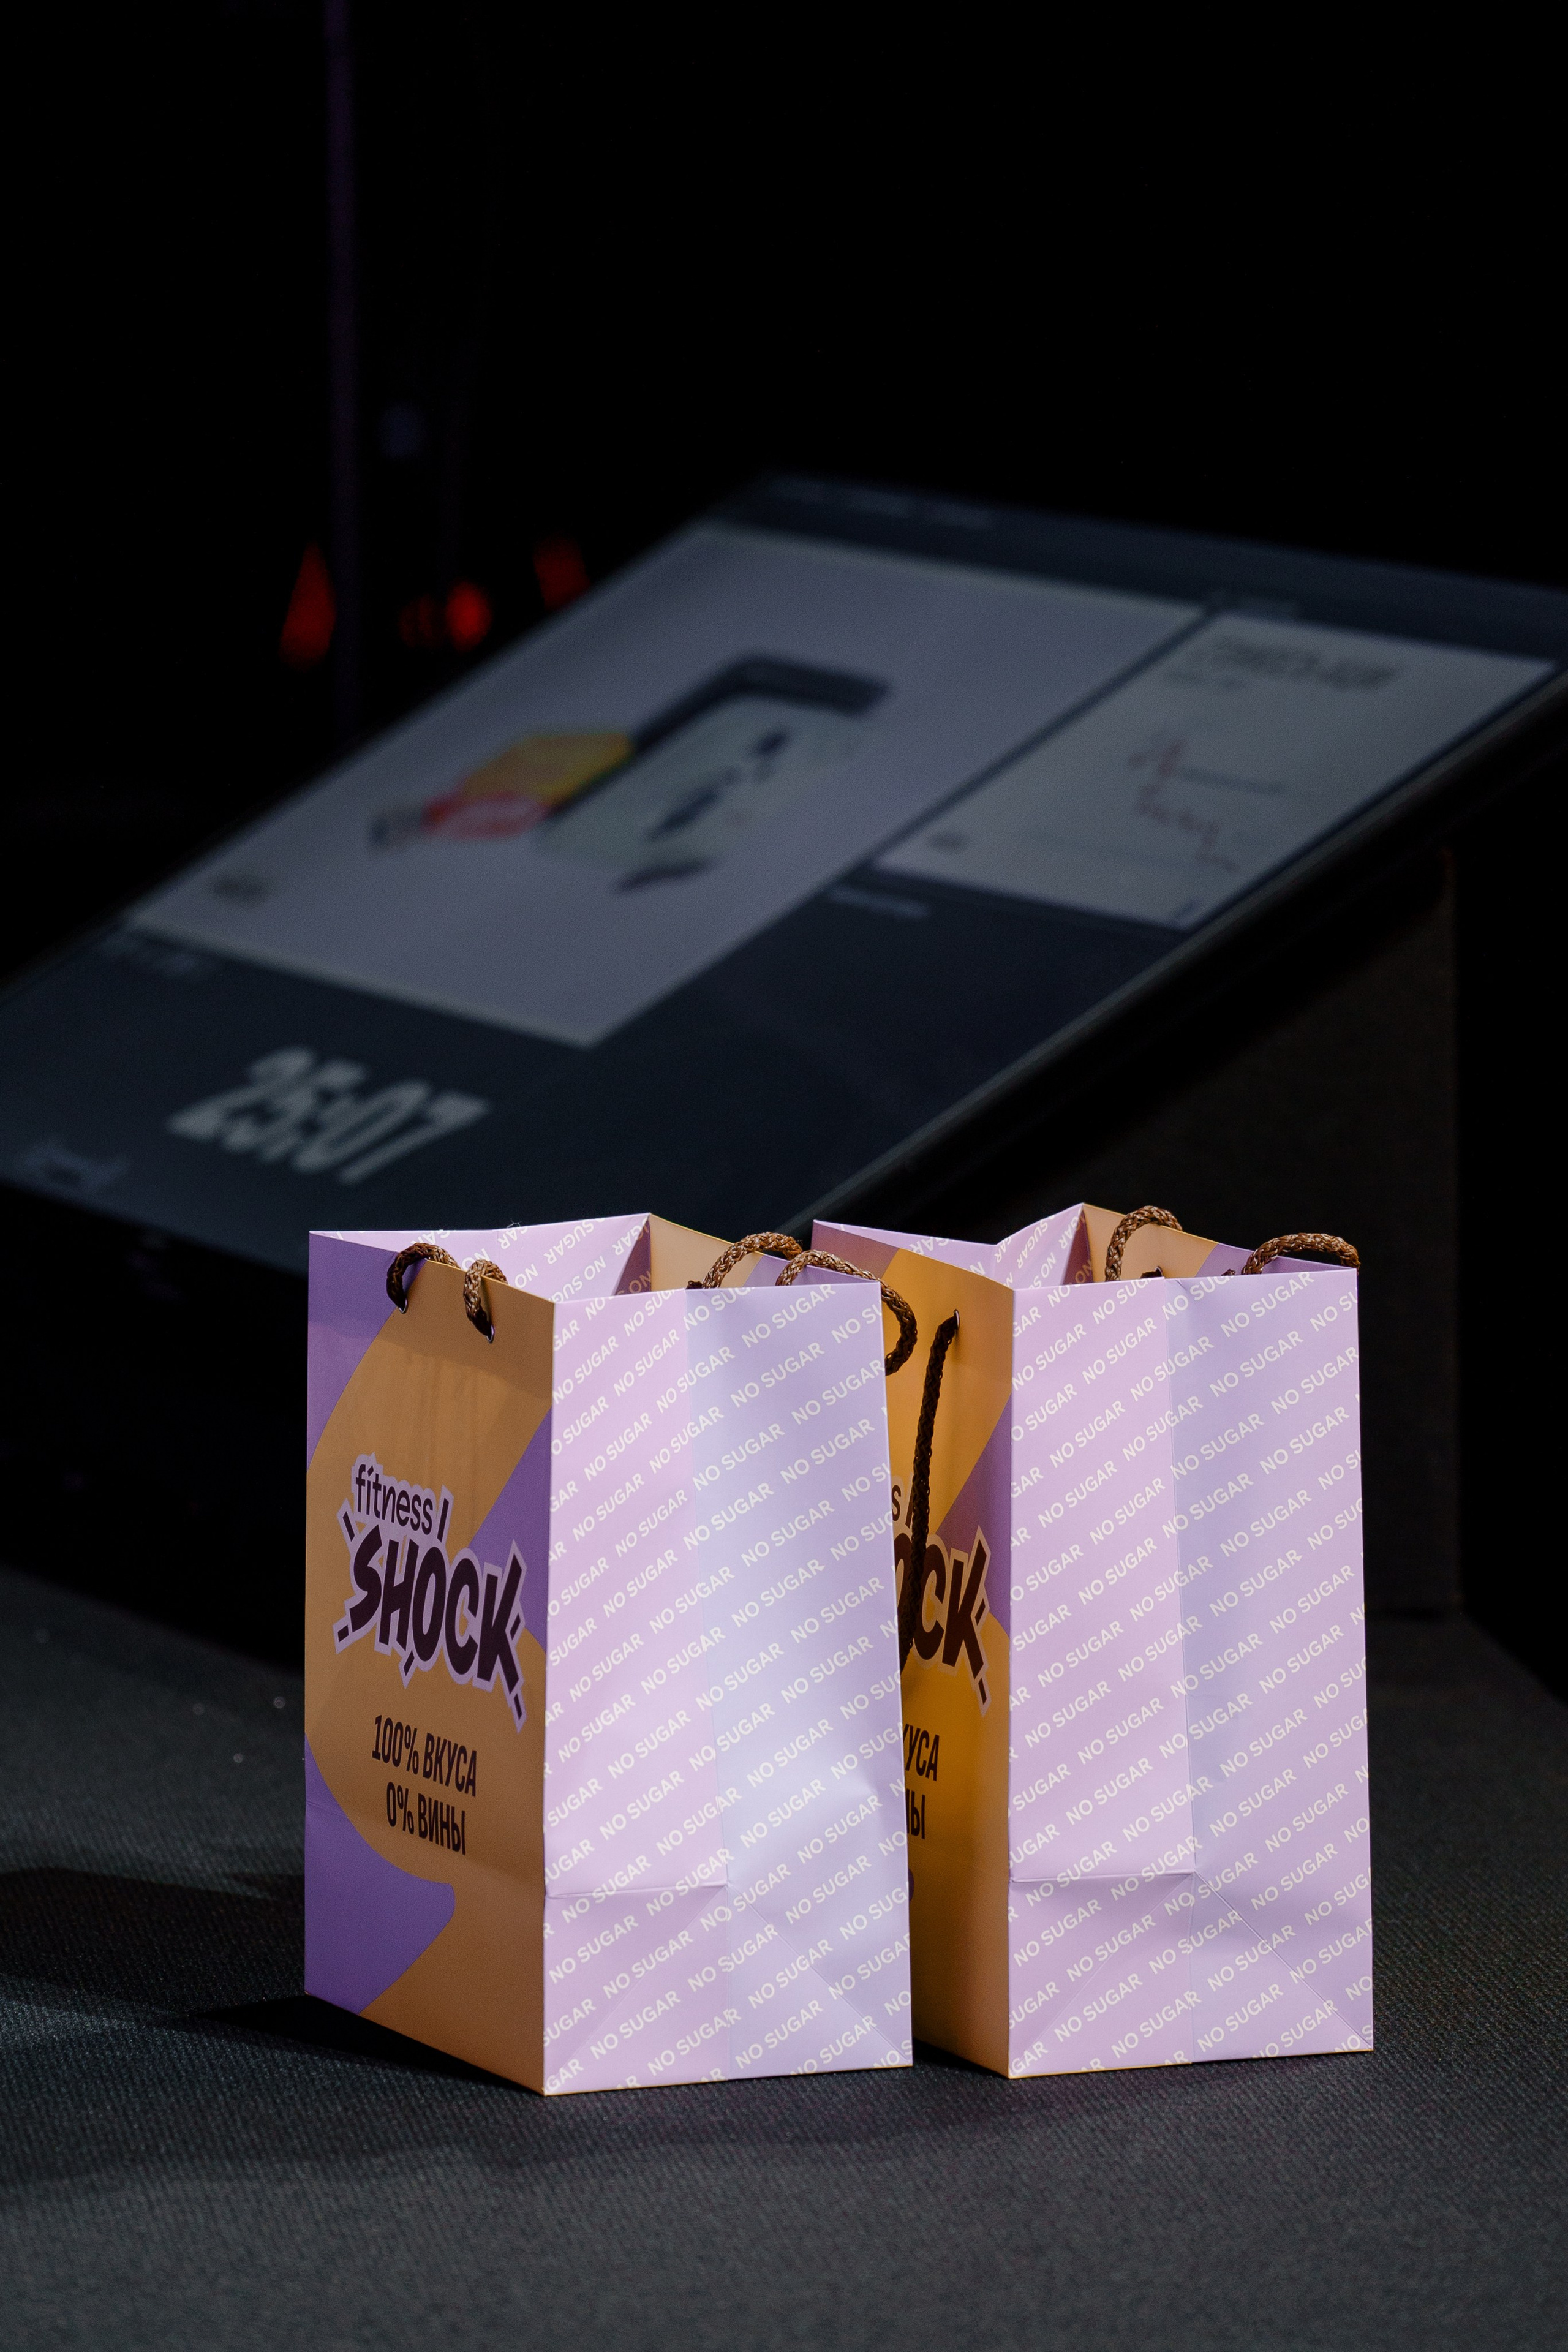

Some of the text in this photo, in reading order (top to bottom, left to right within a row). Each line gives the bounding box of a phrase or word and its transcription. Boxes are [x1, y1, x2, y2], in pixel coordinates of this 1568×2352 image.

[514, 1263, 539, 1289] NO
[1220, 1272, 1314, 1338] NO SUGAR
[741, 1285, 836, 1348] NO SUGAR
[613, 1329, 680, 1397] NO SUGAR
[656, 1346, 735, 1414] NO SUGAR
[730, 1342, 825, 1408] NO SUGAR
[1012, 1323, 1087, 1391] NO SUGAR
[1082, 1317, 1158, 1385] NO SUGAR
[1129, 1336, 1215, 1401] NO SUGAR
[1209, 1330, 1304, 1398] NO SUGAR
[791, 1359, 884, 1425] NO SUGAR
[584, 1412, 652, 1482] NO SUGAR
[649, 1406, 724, 1474] NO SUGAR
[692, 1423, 785, 1491] NO SUGAR
[780, 1419, 875, 1484] NO SUGAR
[1049, 1400, 1126, 1468] NO SUGAR
[1122, 1396, 1204, 1461] NO SUGAR
[1170, 1413, 1265, 1480] NO SUGAR
[1259, 1406, 1350, 1475] NO SUGAR
[355, 1463, 434, 1536] fitness
[572, 1473, 644, 1542] NO SUGAR
[615, 1490, 688, 1558] NO SUGAR
[683, 1483, 775, 1550] NO SUGAR
[1038, 1460, 1118, 1528] NO SUGAR
[1089, 1477, 1166, 1545] NO SUGAR
[1161, 1472, 1254, 1539] NO SUGAR
[1219, 1490, 1312, 1557] NO SUGAR
[741, 1500, 835, 1567] NO SUGAR
[603, 1549, 679, 1618] NO SUGAR
[649, 1566, 735, 1634] NO SUGAR
[731, 1559, 825, 1627] NO SUGAR
[1078, 1537, 1158, 1605] NO SUGAR
[1129, 1556, 1213, 1622] NO SUGAR
[1209, 1550, 1303, 1617] NO SUGAR
[1269, 1565, 1355, 1634] NO SUGAR
[349, 1524, 522, 1695] SHOCK
[790, 1577, 884, 1643] NO SUGAR
[569, 1633, 644, 1702] NO SUGAR
[640, 1627, 726, 1695] NO SUGAR
[695, 1643, 785, 1711] NO SUGAR
[780, 1636, 874, 1704] NO SUGAR
[1037, 1621, 1124, 1688] NO SUGAR
[1118, 1616, 1203, 1682] NO SUGAR
[1259, 1624, 1344, 1694] NO SUGAR
[558, 1694, 636, 1763] NO SUGAR
[608, 1710, 691, 1779] NO SUGAR
[688, 1703, 775, 1771] NO SUGAR
[1024, 1681, 1112, 1749] NO SUGAR
[1077, 1697, 1164, 1765] NO SUGAR
[1159, 1692, 1253, 1759] NO SUGAR
[1219, 1708, 1308, 1777] NO SUGAR
[372, 1714, 477, 1797] 100% ВКУСА
[747, 1719, 834, 1788] NO SUGAR
[386, 1781, 466, 1856] 0% ВИНЫ
[599, 1770, 684, 1841] NO SUGAR
[740, 1779, 826, 1849] NO SUGAR
[1065, 1757, 1153, 1825] NO SUGAR
[1209, 1768, 1297, 1838] NO SUGAR
[1264, 1783, 1349, 1853] NO SUGAR
[797, 1838, 823, 1864] NO
[824, 1795, 883, 1844] SUGAR
[562, 1855, 652, 1924] NO SUGAR
[785, 1855, 872, 1924] NO SUGAR
[1251, 1843, 1338, 1910] NO SUGAR
[548, 1915, 639, 1984] NO SUGAR
[602, 1930, 694, 1999] NO SUGAR
[687, 1924, 778, 1992] NO SUGAR
[1013, 1899, 1102, 1967] NO SUGAR
[1066, 1914, 1156, 1982] NO SUGAR
[748, 1939, 834, 2009] NO SUGAR
[1054, 1973, 1143, 2043] NO SUGAR
[590, 1991, 681, 2060] NO SUGAR
[734, 2000, 823, 2069] NO SUGAR
[1197, 1983, 1284, 2052] NO SUGAR
